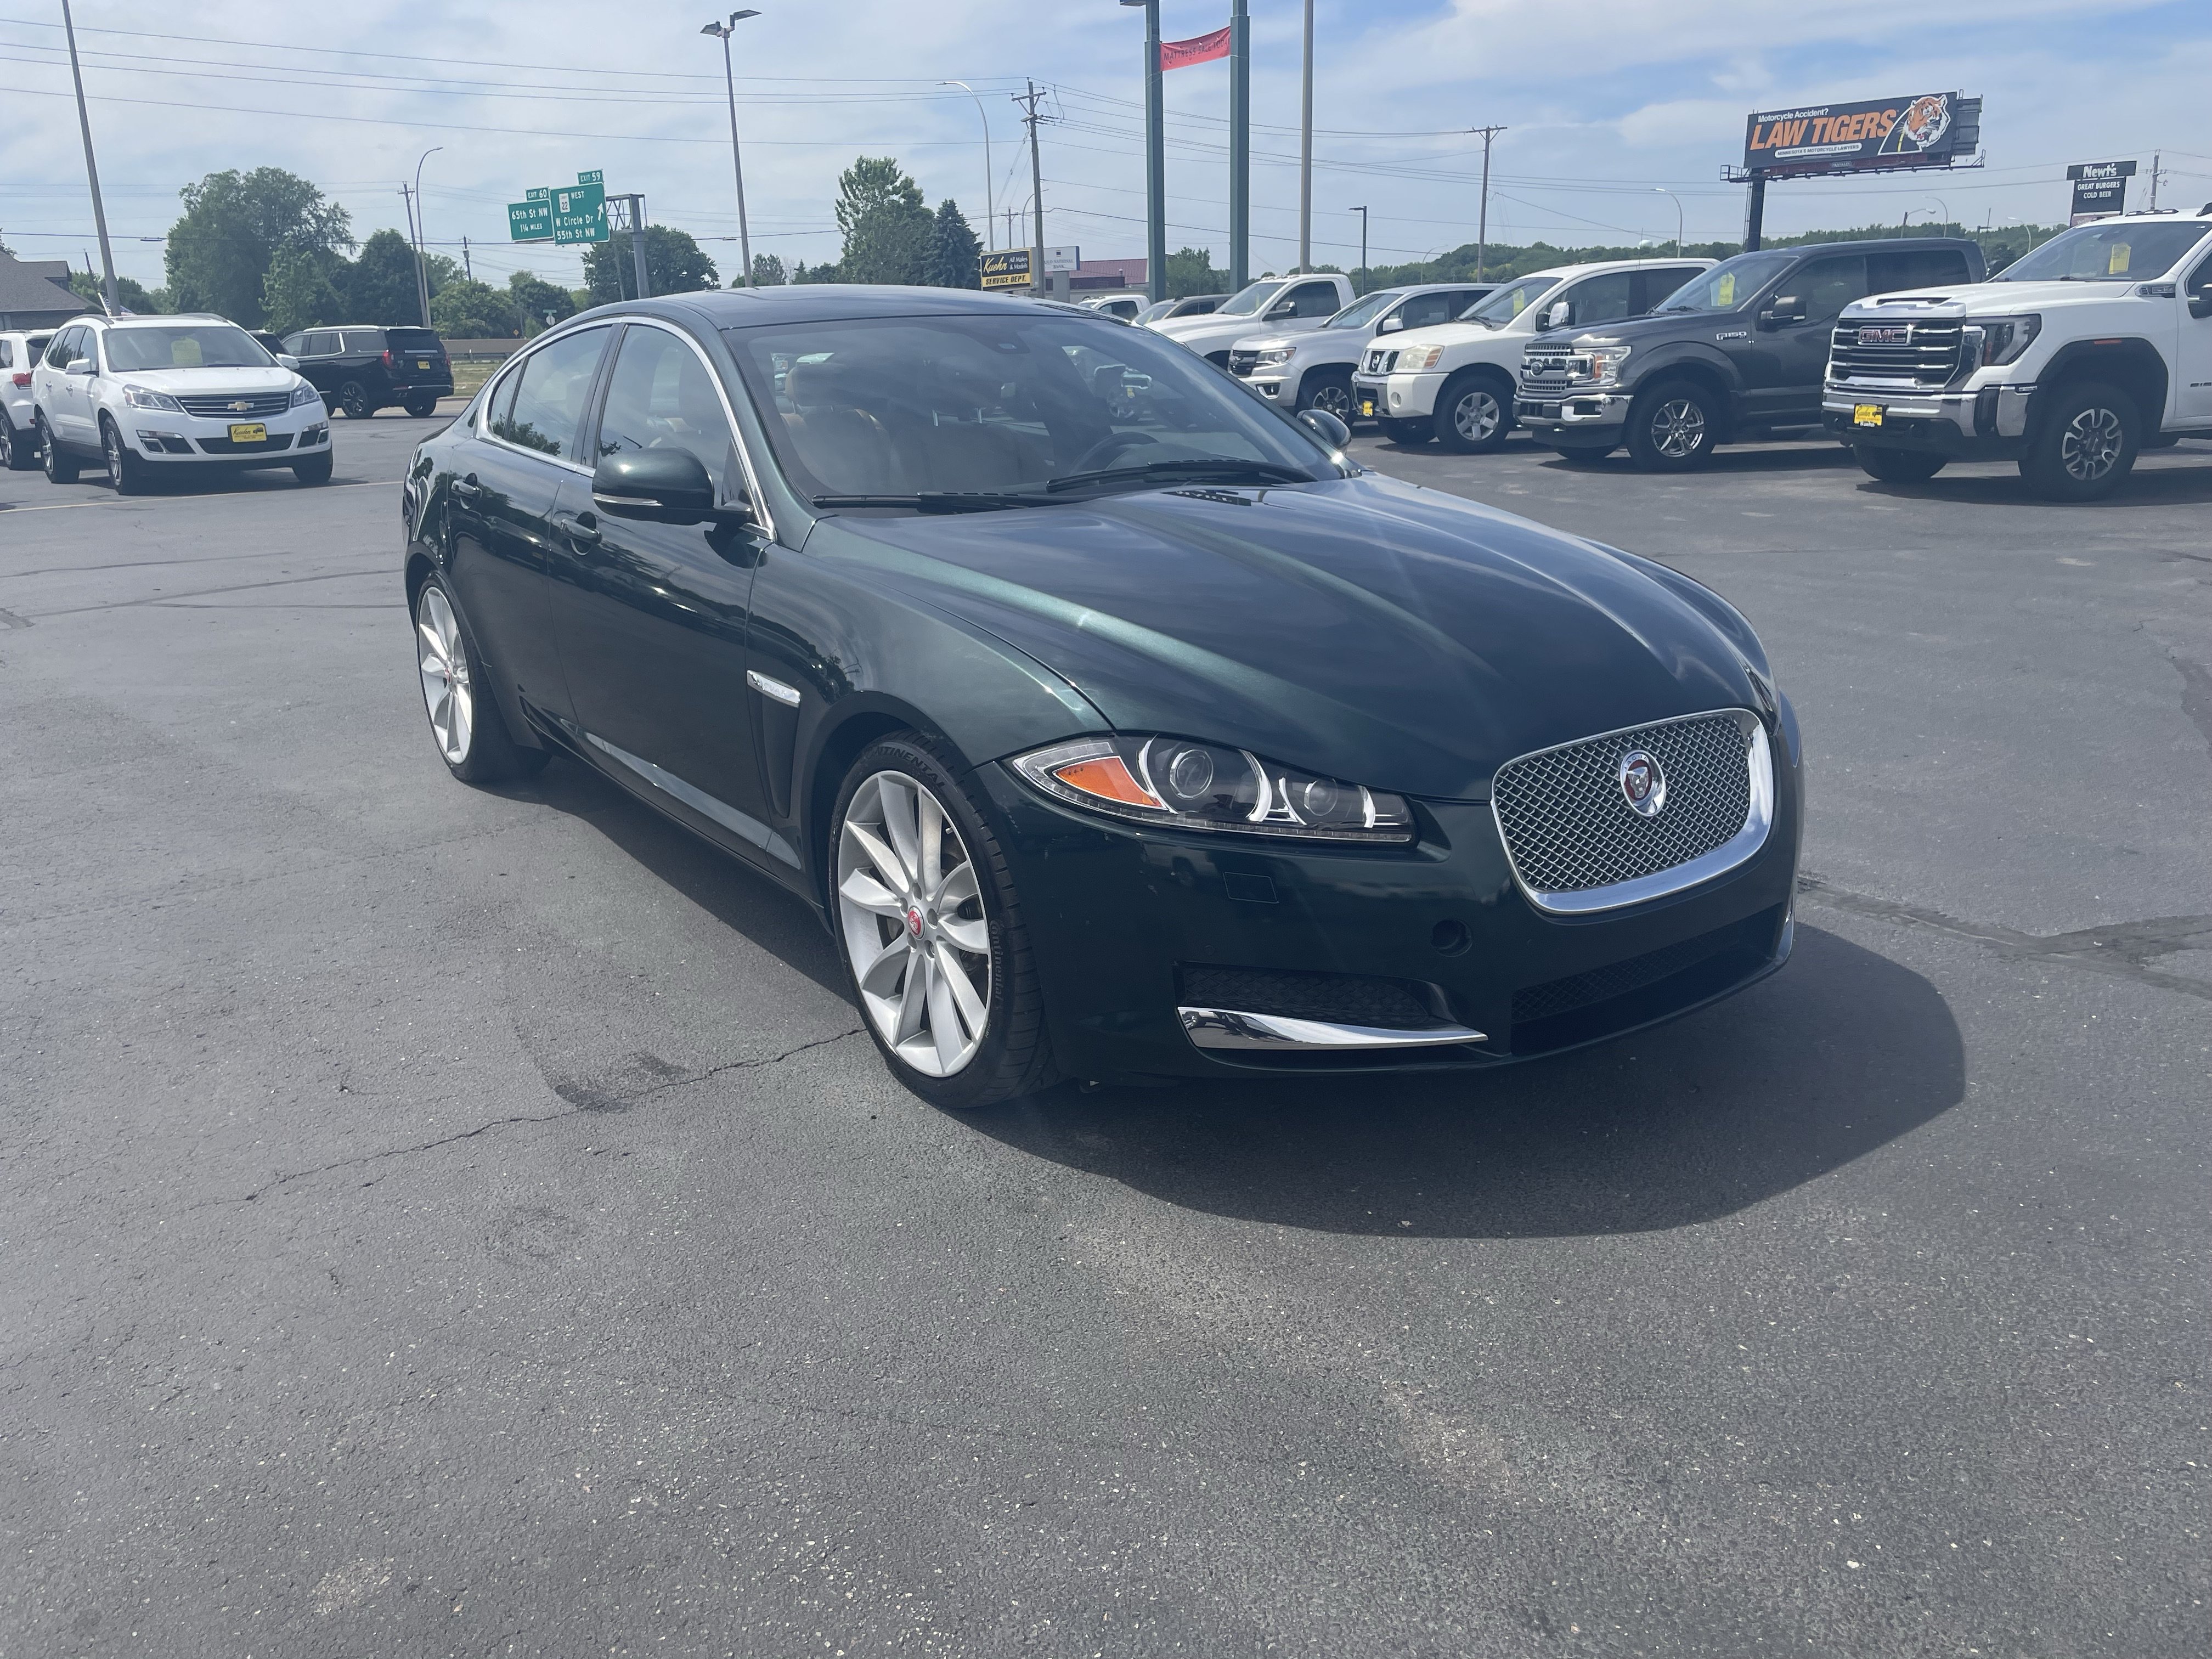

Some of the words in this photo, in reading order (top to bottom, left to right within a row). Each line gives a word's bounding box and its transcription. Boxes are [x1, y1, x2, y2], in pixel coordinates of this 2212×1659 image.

[1164, 47, 1196, 61] MATTRESS
[1198, 44, 1211, 55] SALE
[1213, 37, 1230, 49] TODA
[1758, 112, 1794, 123] Motorcycle
[1794, 108, 1829, 119] Accident?
[1750, 119, 1809, 150] LAW
[1812, 109, 1897, 144] TIGERS
[580, 174, 590, 182] EXIT
[591, 171, 601, 182] 59
[2083, 162, 2117, 178] Newt's
[2095, 181, 2120, 190] BURGERS
[539, 188, 548, 198] 60
[571, 190, 584, 199] WEST
[561, 201, 568, 210] 22
[511, 210, 527, 220] 65th
[529, 208, 537, 218] St
[538, 207, 548, 217] NW
[555, 217, 561, 227] W
[563, 215, 583, 227] Circle
[585, 214, 594, 224] Dr
[557, 230, 573, 240] 55th
[575, 228, 583, 239] St
[585, 227, 595, 238] NW
[983, 256, 1008, 274] Kuehn
[985, 276, 1009, 285] SERVICE
[1011, 275, 1027, 283] DEPT.
[1860, 329, 1907, 343] GMC
[1624, 754, 1649, 773] JAGUA
[989, 919, 1005, 1001] Continental
